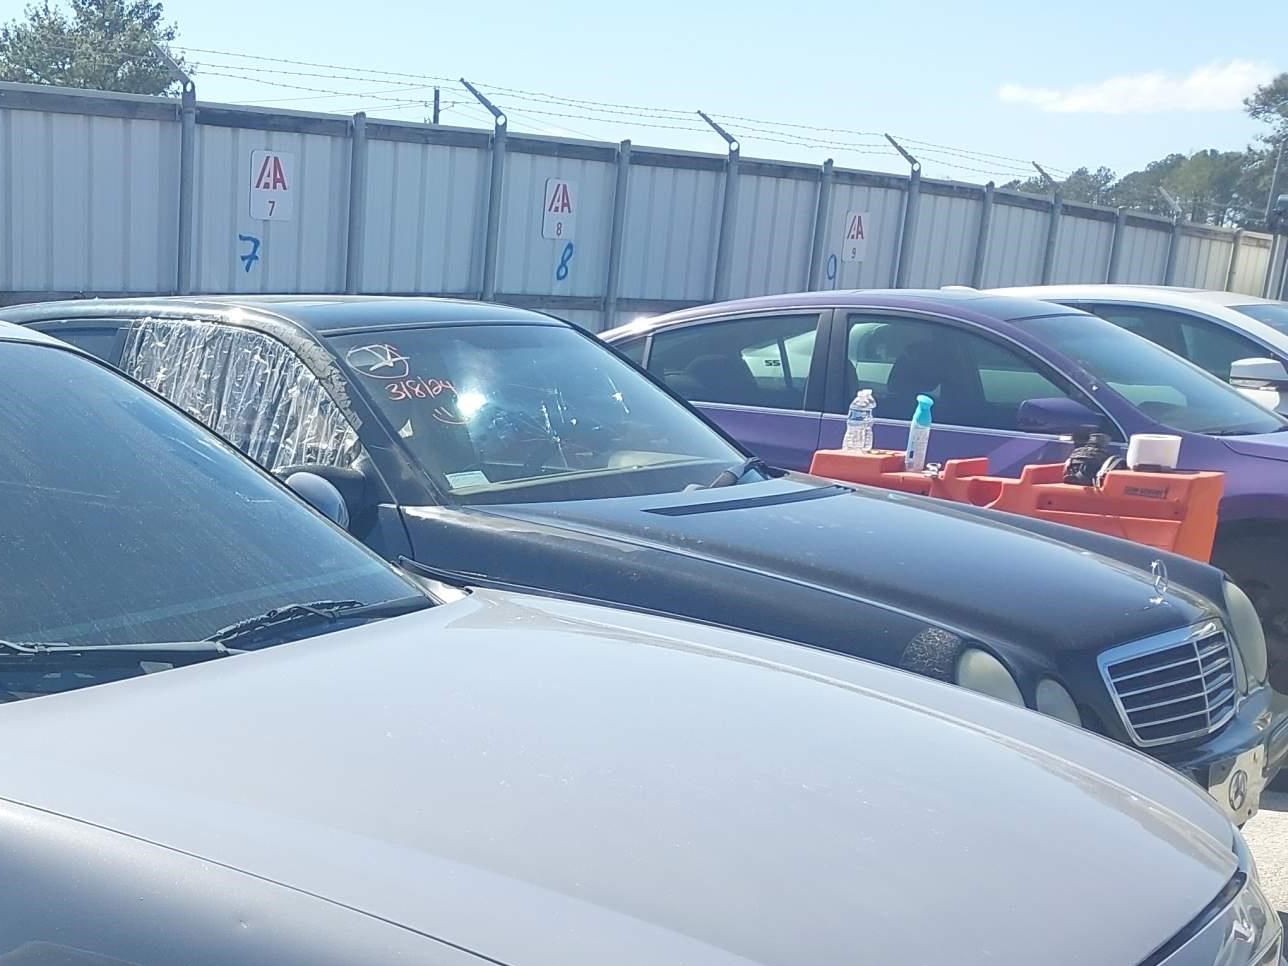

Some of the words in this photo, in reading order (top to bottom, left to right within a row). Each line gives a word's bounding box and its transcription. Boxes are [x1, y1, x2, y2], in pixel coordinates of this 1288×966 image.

[267, 201, 276, 216] 7
[556, 222, 562, 236] 8
[238, 233, 260, 273] 7
[556, 242, 574, 281] 8
